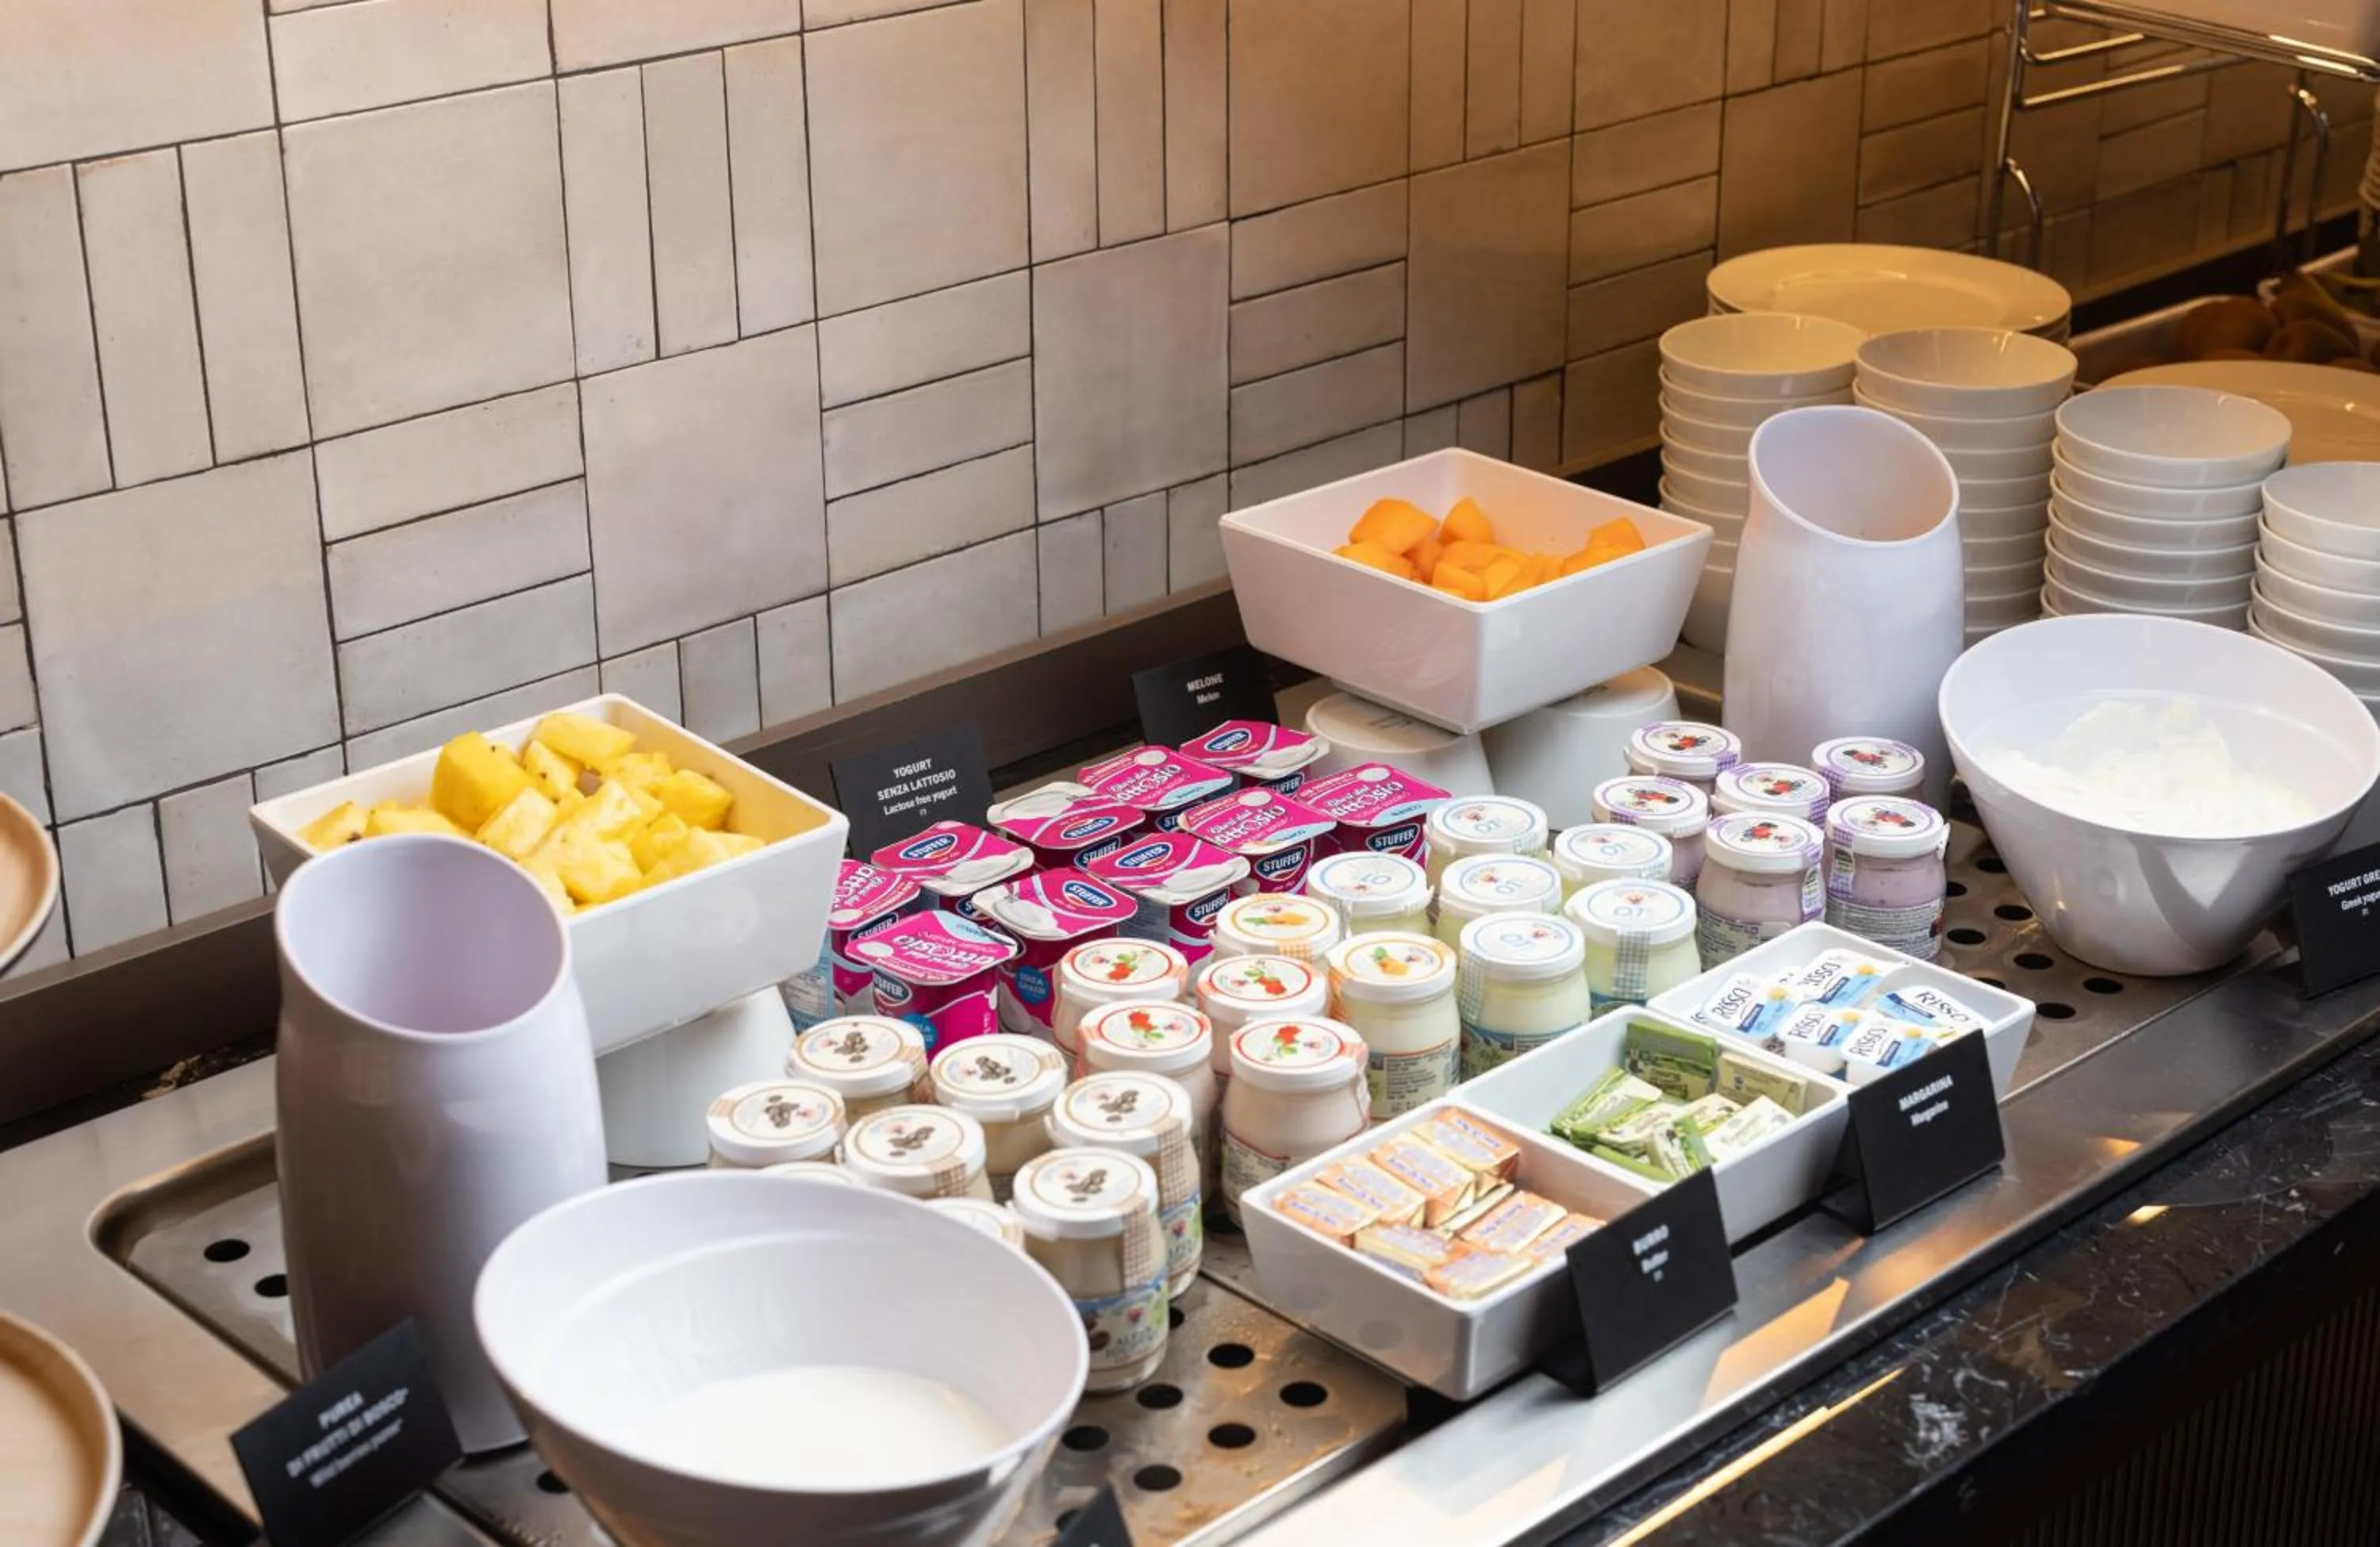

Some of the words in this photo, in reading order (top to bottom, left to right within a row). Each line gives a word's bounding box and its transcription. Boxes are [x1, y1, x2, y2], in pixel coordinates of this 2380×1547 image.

[1186, 673, 1225, 692] MELONE
[892, 758, 932, 778] YOGURT
[877, 784, 910, 800] SENZA
[911, 769, 957, 792] LATTOSIO
[883, 800, 915, 816] Lactose
[915, 796, 932, 808] free
[932, 785, 958, 803] yogurt
[1375, 829, 1416, 847] STUFFER
[1263, 853, 1303, 872] STUFFER
[1070, 884, 1108, 907] STUFFER
[2328, 876, 2362, 896] YOGURT
[1194, 893, 1229, 917] STUFFER
[1914, 992, 1969, 1023] RISSO
[1898, 1074, 1954, 1111] MARGARINA
